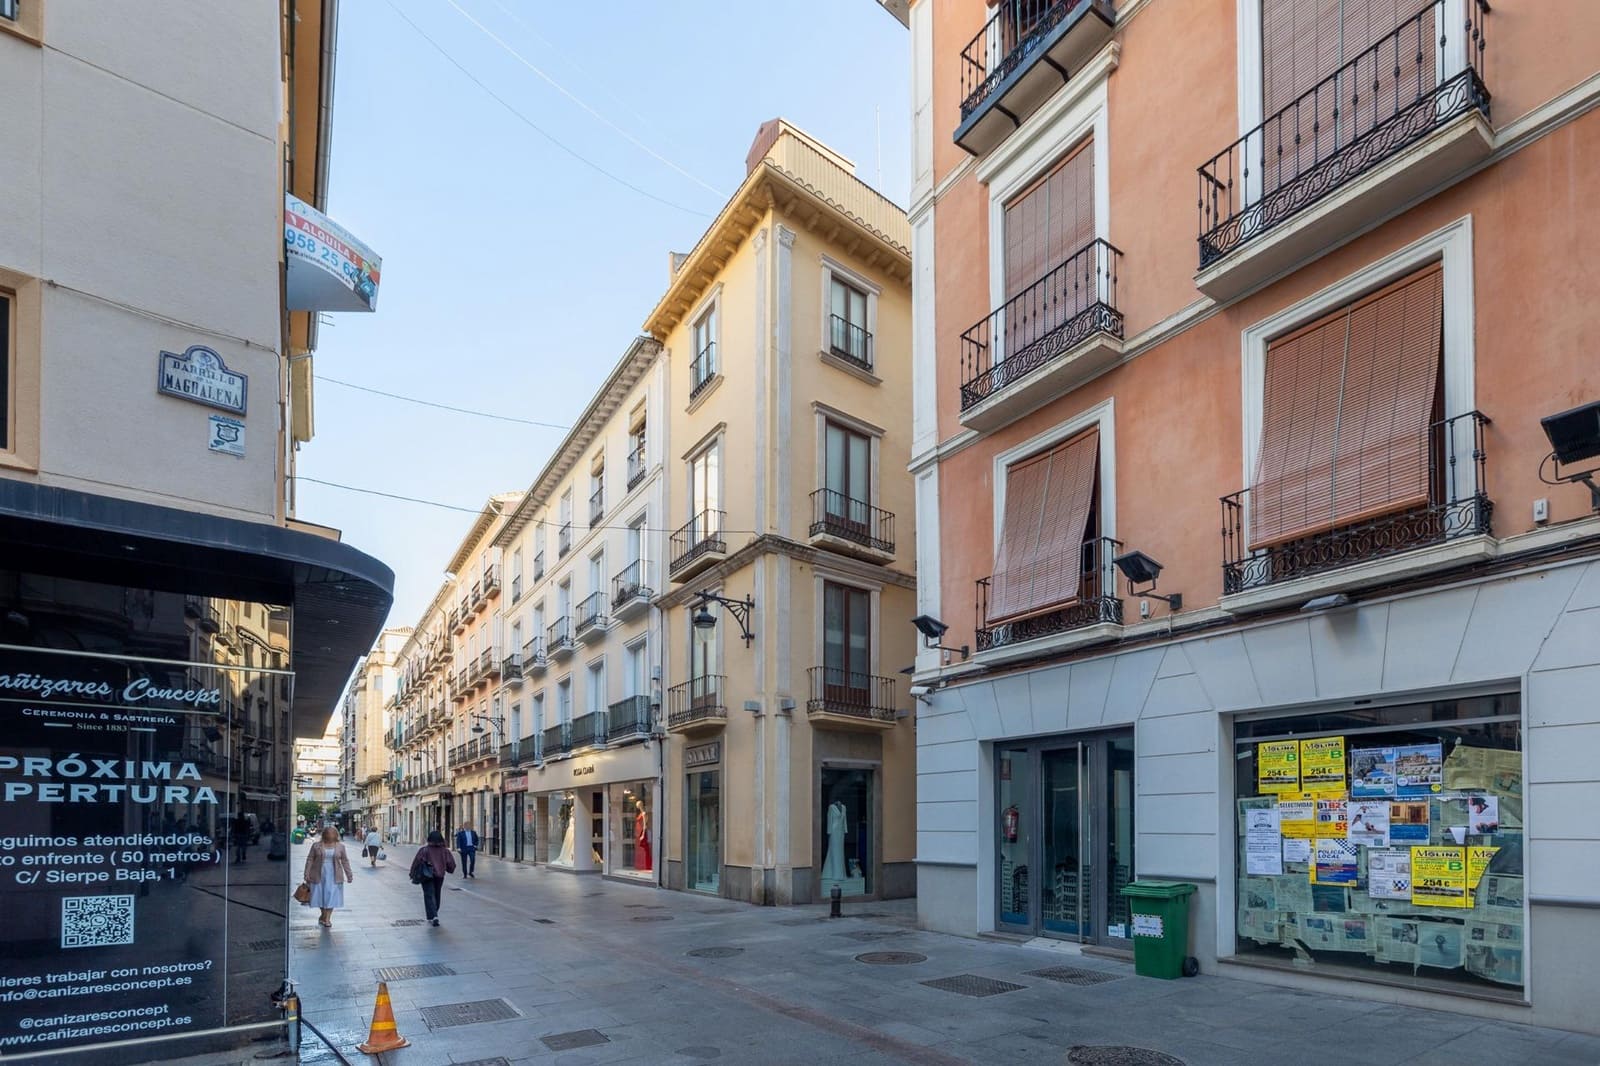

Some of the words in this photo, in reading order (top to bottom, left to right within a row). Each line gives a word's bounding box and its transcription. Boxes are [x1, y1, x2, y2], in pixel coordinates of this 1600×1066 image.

[286, 228, 316, 253] 958
[321, 246, 340, 266] 25
[165, 373, 240, 406] MAGDALENA
[123, 678, 220, 706] Concept
[22, 708, 96, 719] CEREMONIA
[113, 714, 176, 724] SASTRERÍA
[76, 722, 103, 731] Since
[106, 724, 128, 732] 1883
[1286, 753, 1296, 761] B
[1330, 750, 1342, 758] B
[0, 834, 78, 850] guimos
[83, 833, 213, 847] atendiéndoles
[0, 855, 15, 866] o
[22, 852, 105, 866] enfrente
[121, 851, 144, 863] 50
[149, 850, 211, 862] metros
[1448, 861, 1463, 870] B
[15, 870, 41, 884] C/
[46, 870, 109, 884] Sierpe
[115, 868, 161, 883] Baja,
[167, 867, 175, 879] 1
[0, 976, 42, 987] ieres
[46, 970, 108, 983] trabajar
[111, 968, 138, 978] con
[143, 960, 212, 975] nosotros?
[20, 1004, 168, 1029] @canizaresconcept
